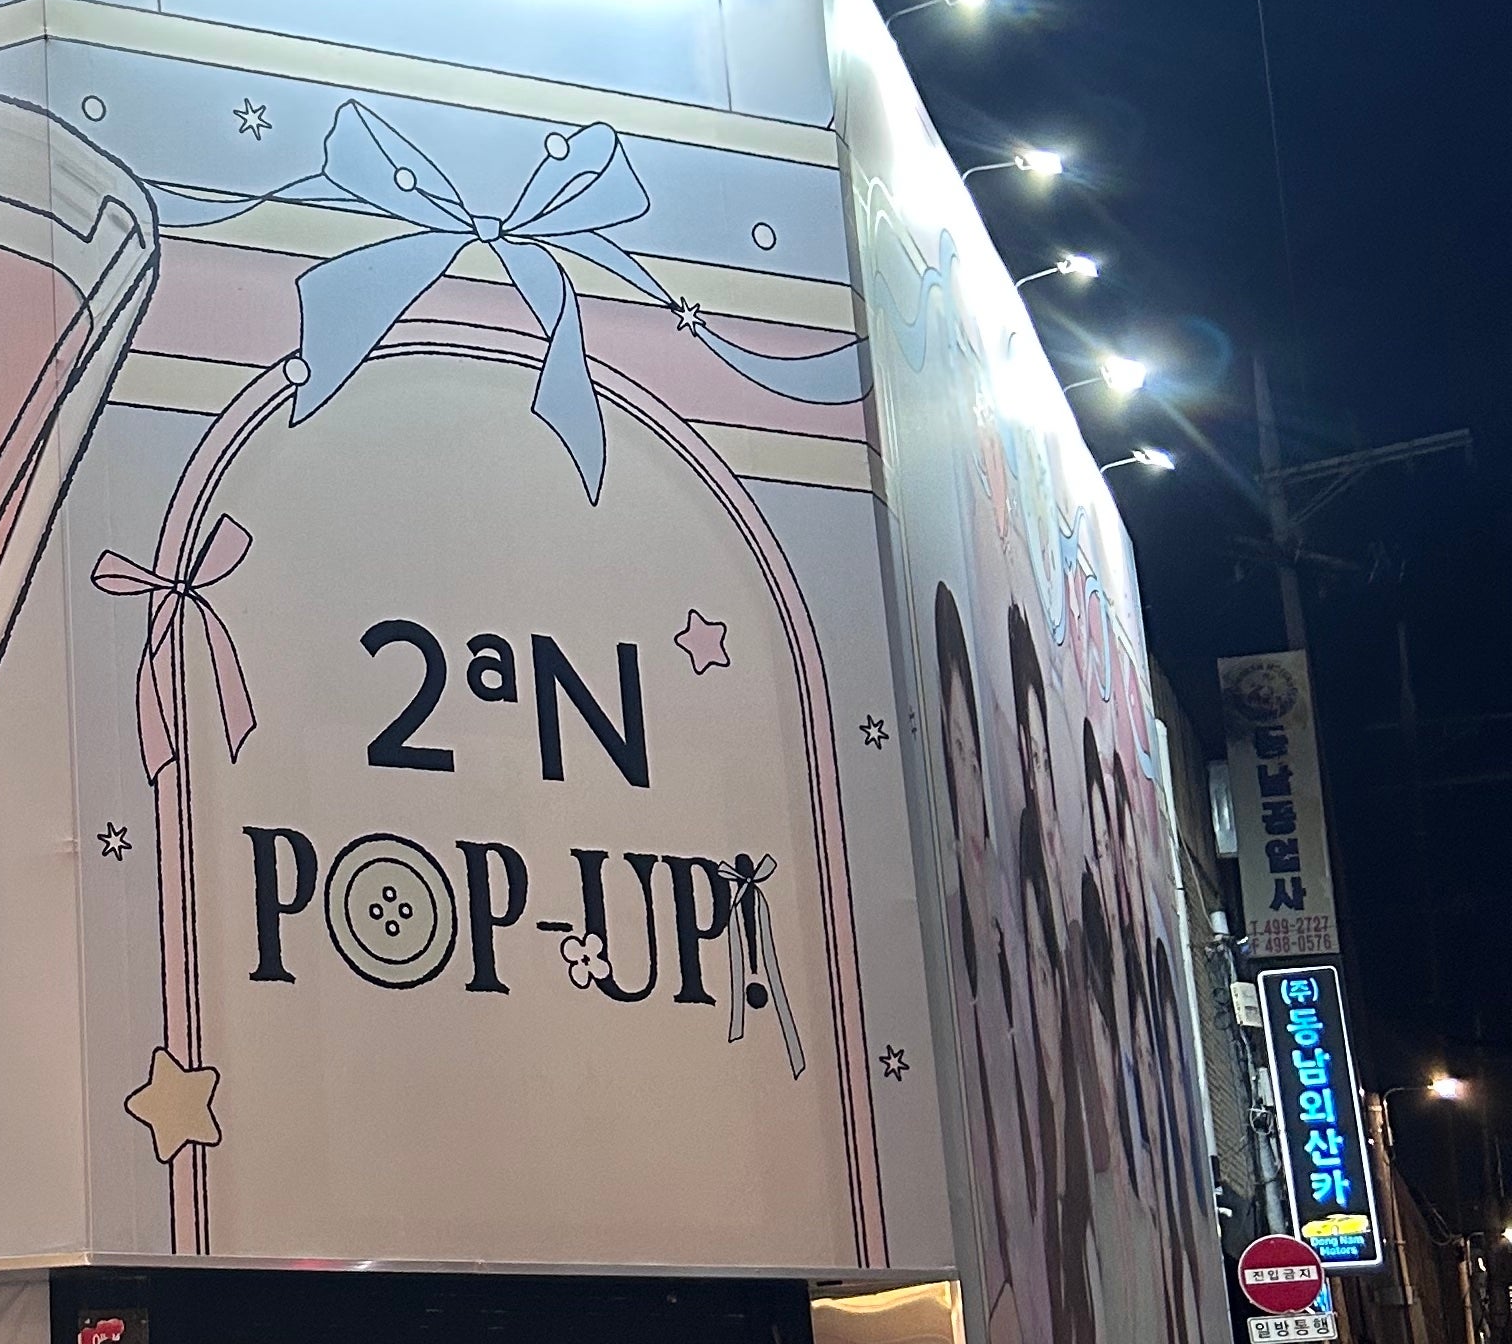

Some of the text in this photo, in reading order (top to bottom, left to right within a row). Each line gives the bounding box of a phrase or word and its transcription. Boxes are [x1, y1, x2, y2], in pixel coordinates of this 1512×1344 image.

[359, 618, 650, 789] 2aN
[242, 826, 769, 1011] POP-UP!
[1265, 933, 1332, 954] 498-0576
[1253, 1268, 1311, 1281] 진입금지
[1255, 1317, 1329, 1338] 일방통행
